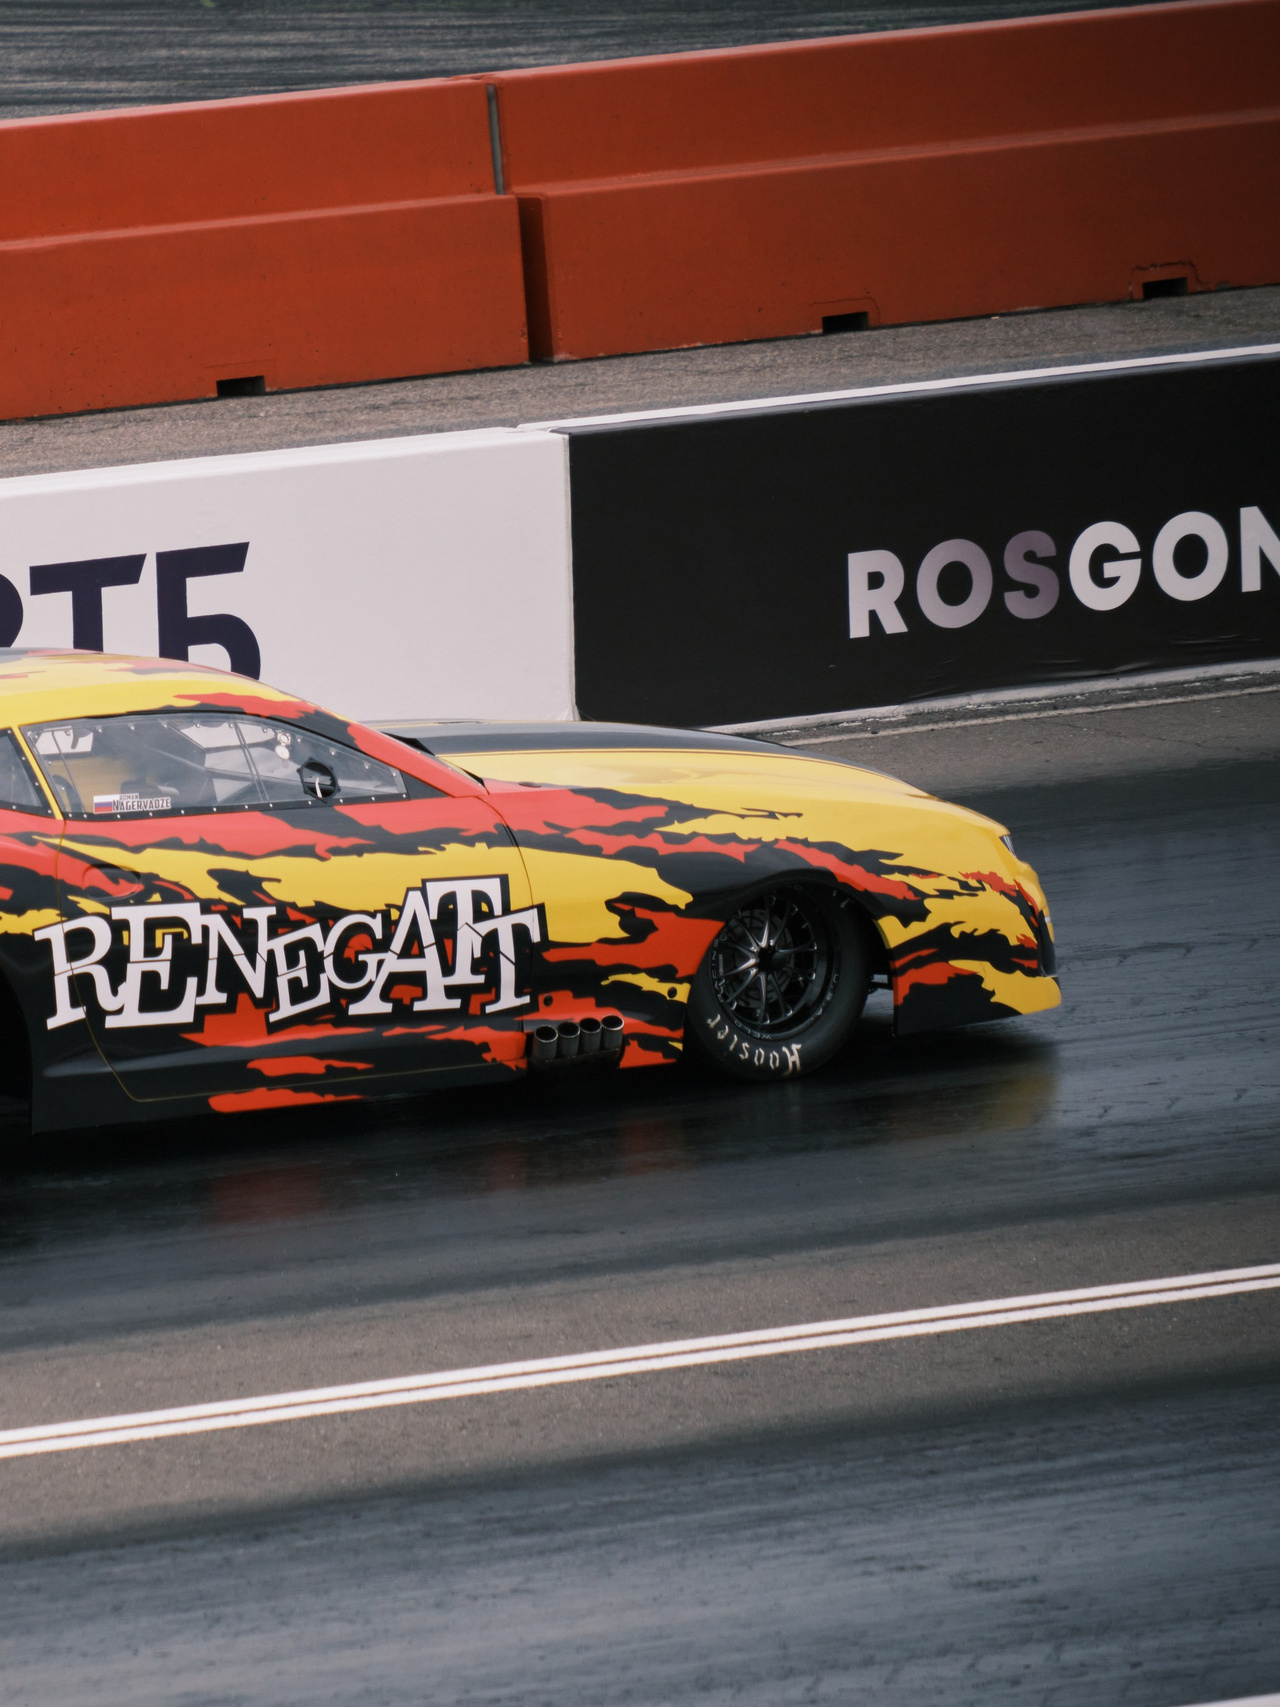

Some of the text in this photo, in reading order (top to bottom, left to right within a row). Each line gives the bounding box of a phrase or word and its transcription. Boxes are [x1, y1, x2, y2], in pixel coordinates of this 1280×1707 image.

[847, 506, 1280, 639] ROSGON
[112, 797, 171, 811] NAGERVADZE
[33, 877, 541, 1030] RENEGATT
